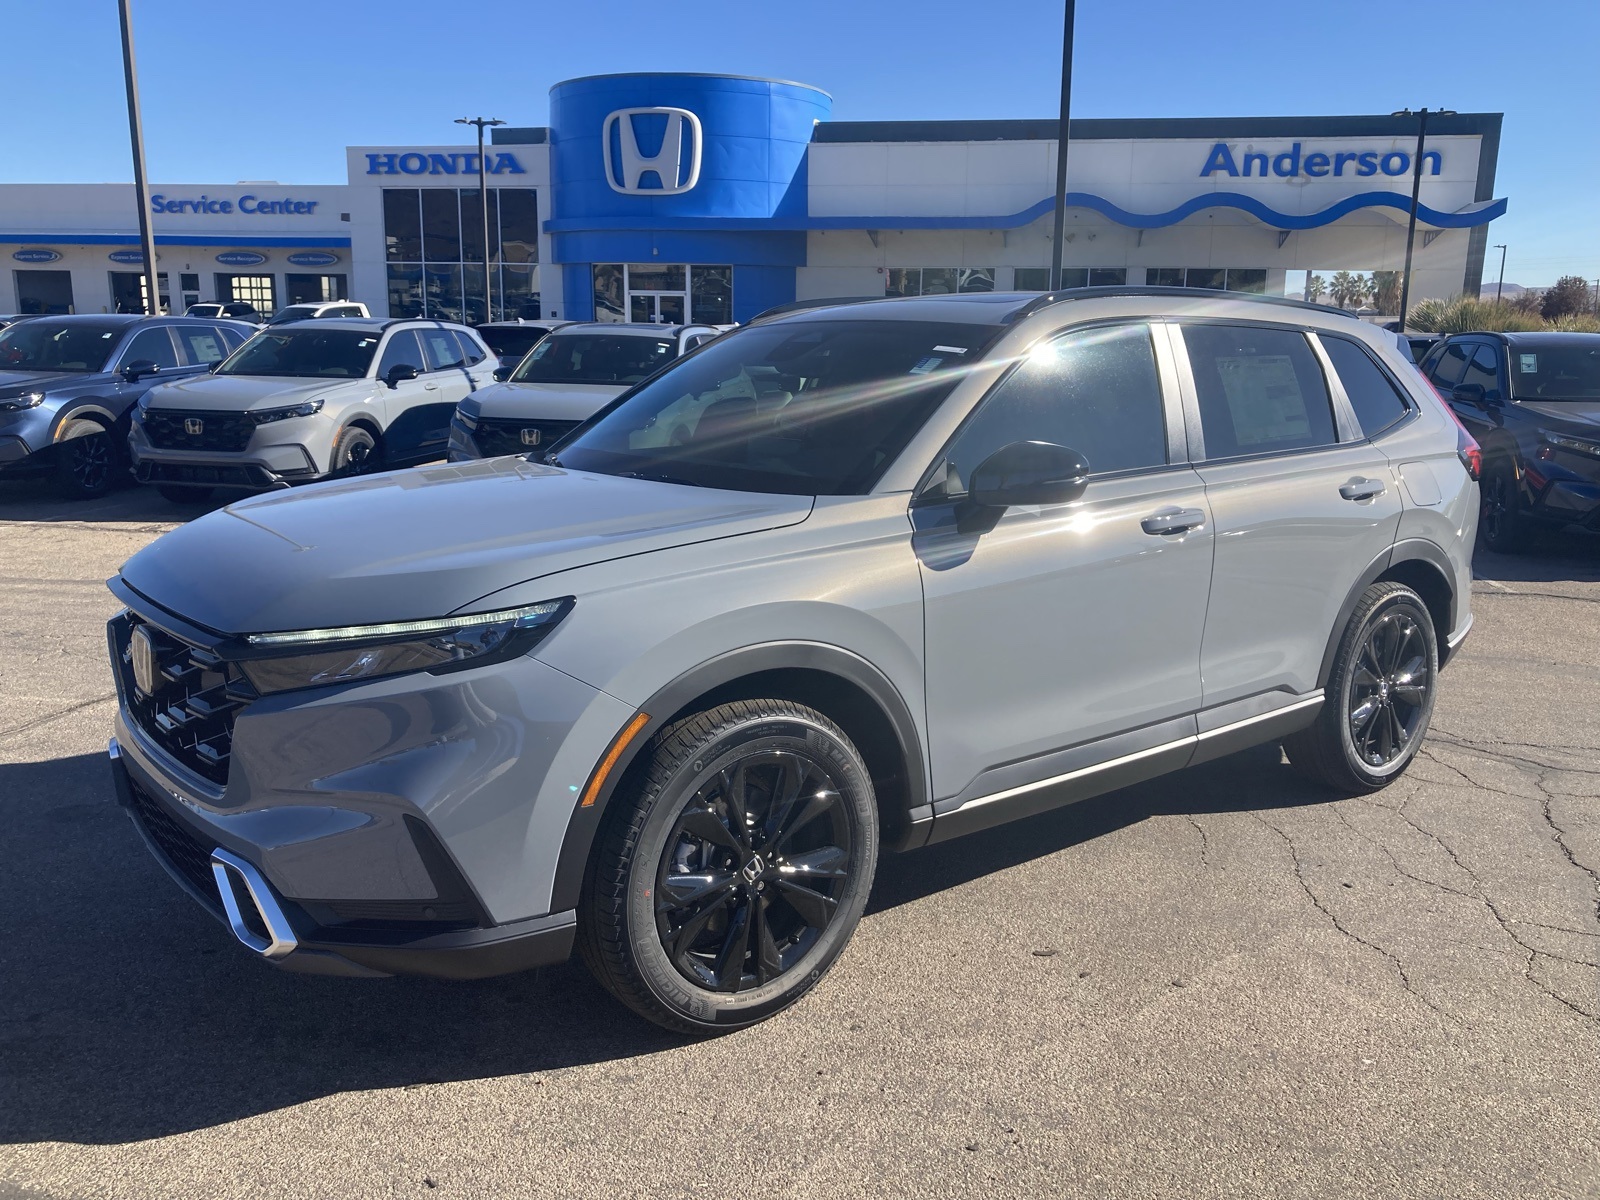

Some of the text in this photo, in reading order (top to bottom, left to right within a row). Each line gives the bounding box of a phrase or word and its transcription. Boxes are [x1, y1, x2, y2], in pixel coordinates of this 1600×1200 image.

[365, 152, 526, 175] HONDA
[1199, 142, 1442, 178] Anderson
[151, 194, 318, 215] Service Center
[863, 825, 872, 871] PRIMACY
[638, 938, 690, 1006] MICHELIN
